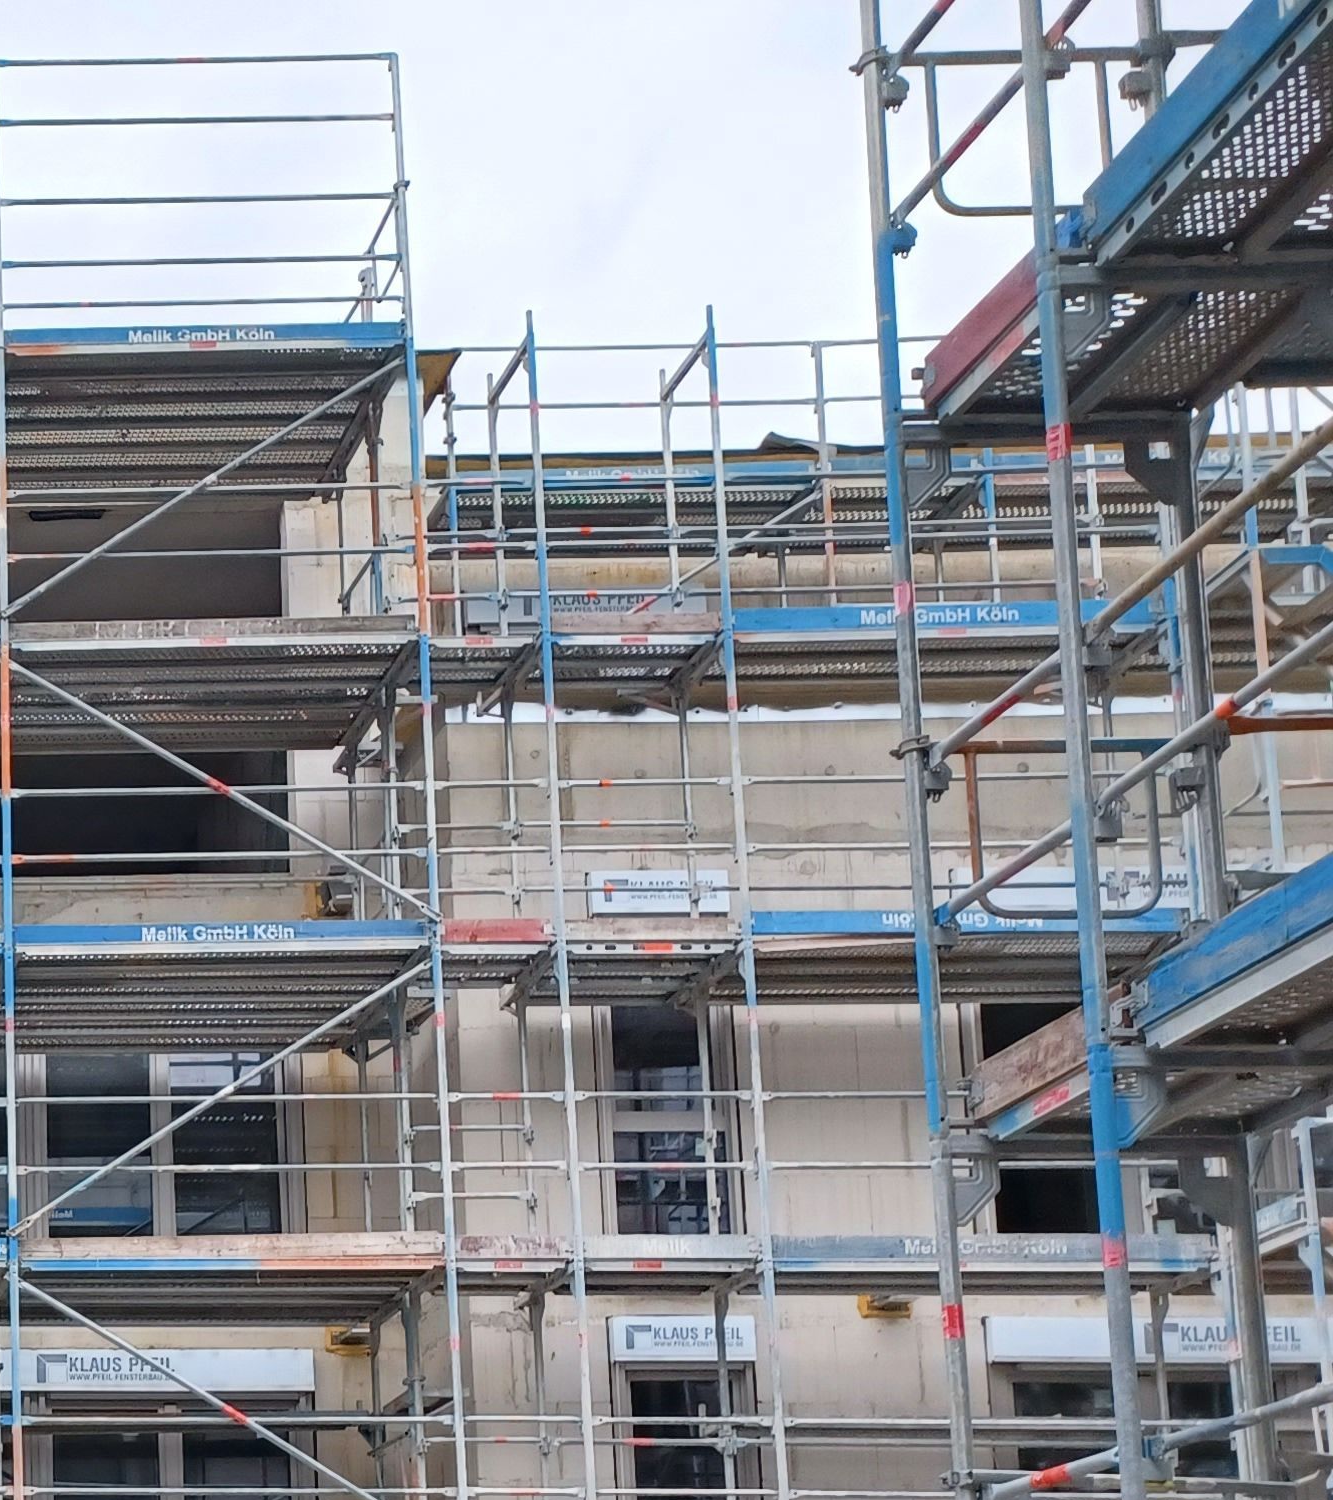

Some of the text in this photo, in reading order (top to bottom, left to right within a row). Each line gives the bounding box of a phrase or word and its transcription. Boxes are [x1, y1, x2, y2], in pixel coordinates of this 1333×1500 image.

[128, 327, 274, 343] Melik GmbH Köln
[860, 606, 1019, 625] Meli GmbH Köln
[141, 924, 296, 942] Melik GmbH Köln
[654, 1327, 699, 1340] KLAUS
[1181, 1326, 1228, 1342] KLAU
[69, 1357, 122, 1372] KLAUS
